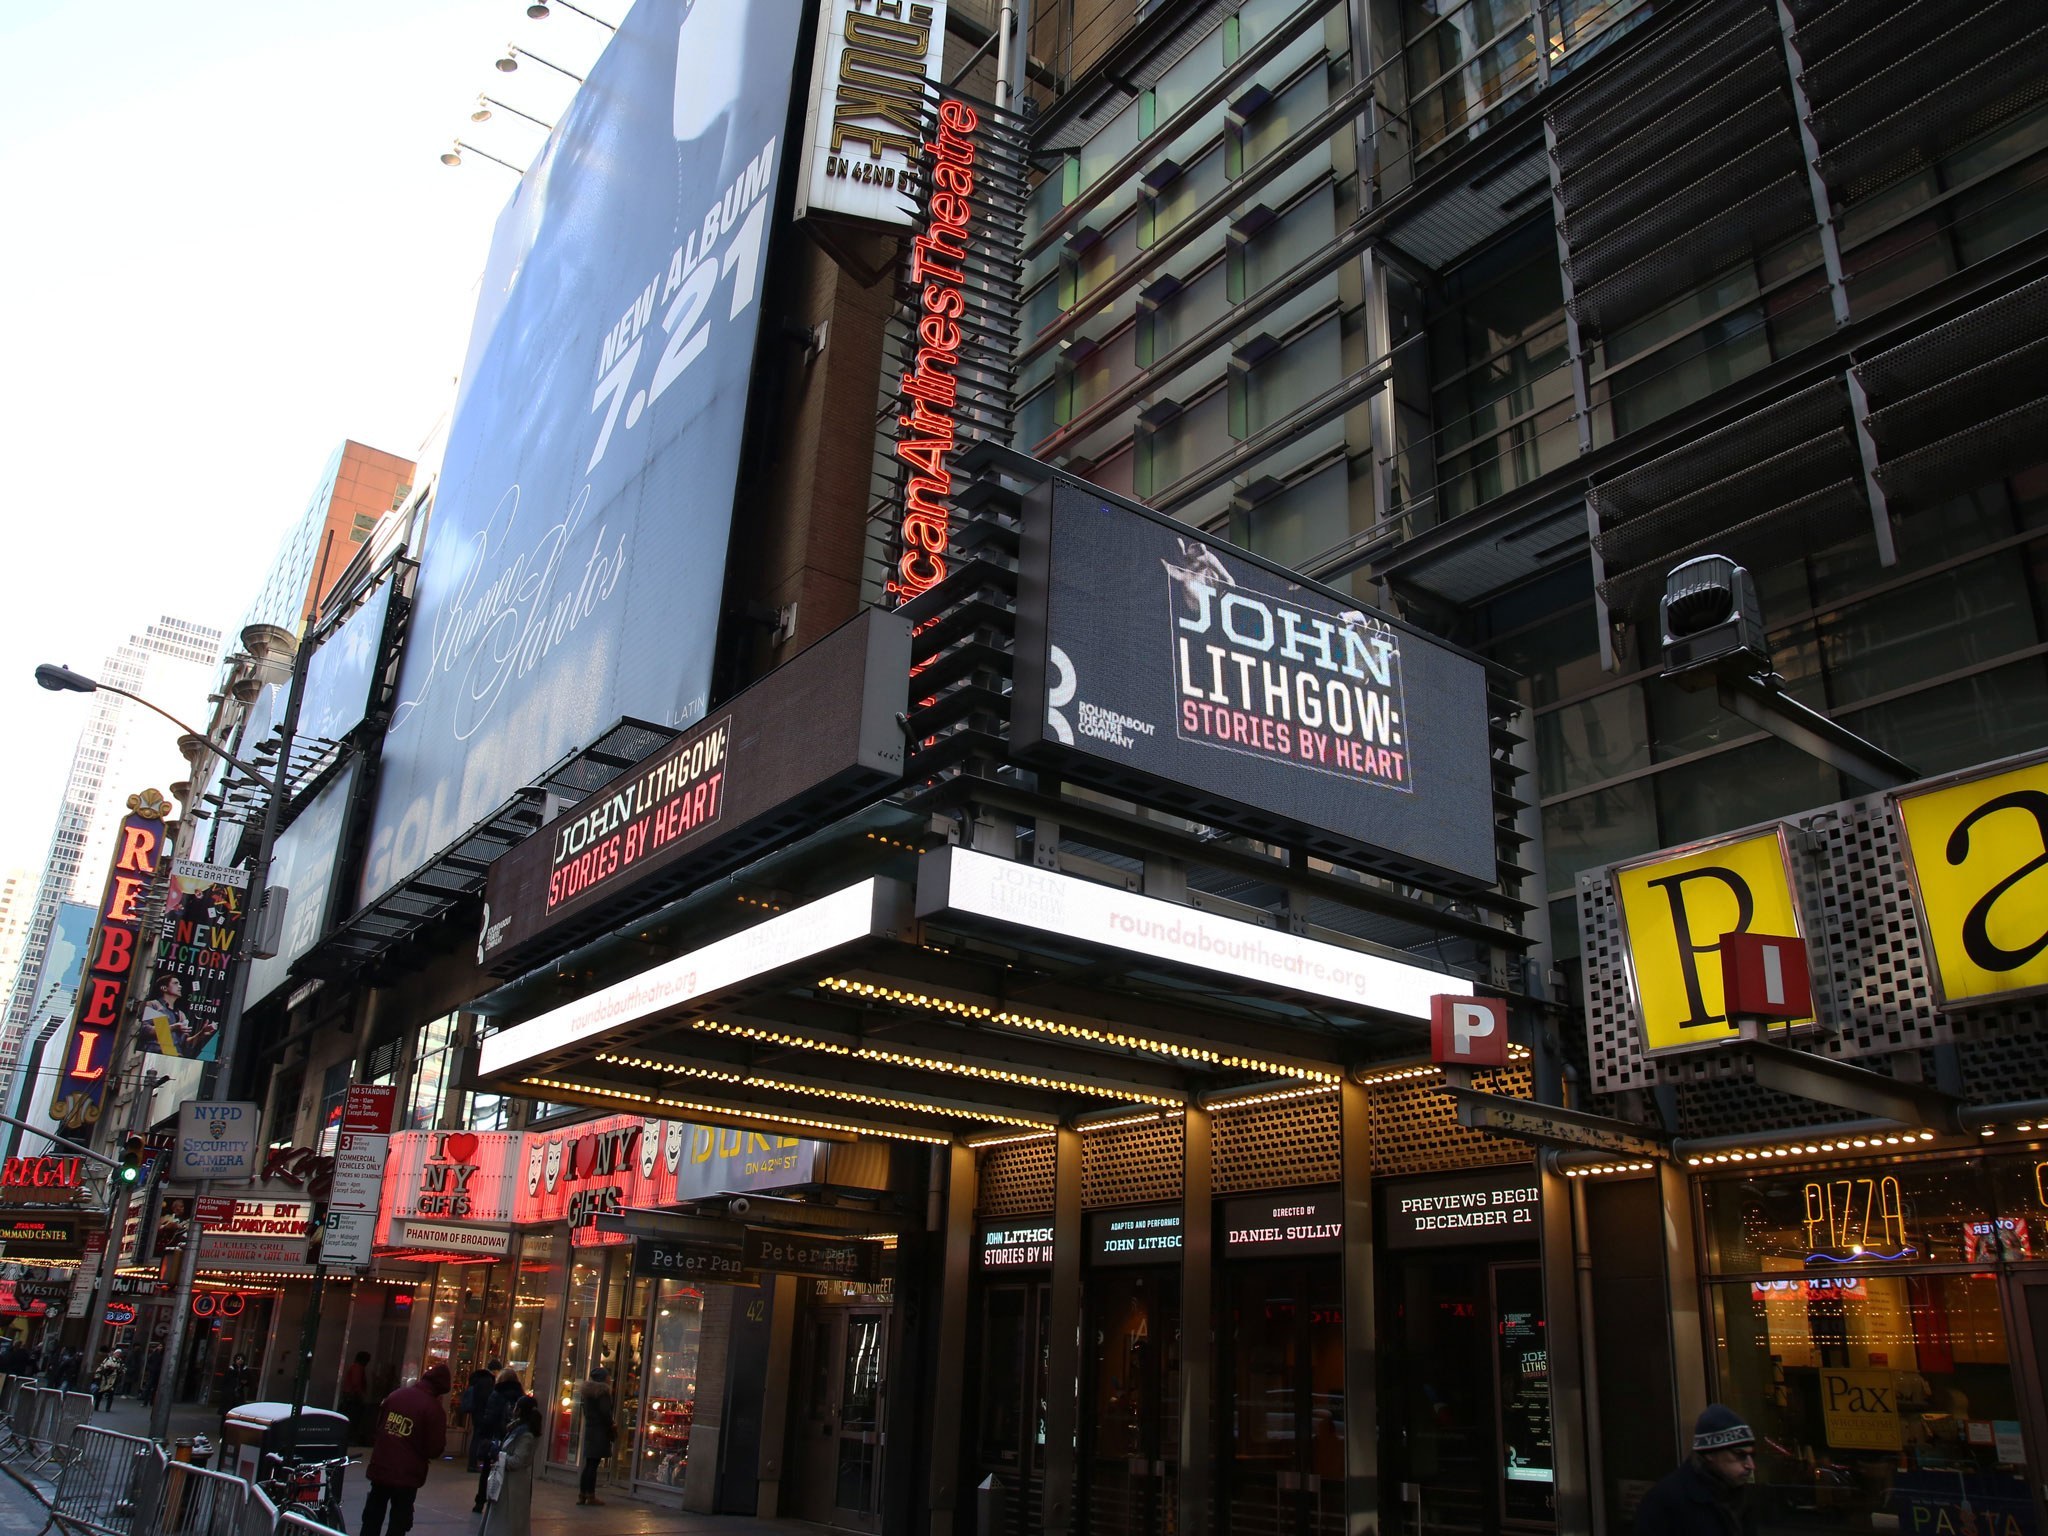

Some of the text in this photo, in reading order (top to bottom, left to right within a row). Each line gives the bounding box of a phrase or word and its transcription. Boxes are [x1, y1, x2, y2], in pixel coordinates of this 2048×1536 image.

[830, 10, 930, 169] DUKE
[826, 155, 849, 179] ON
[852, 161, 895, 188] 42ND
[597, 134, 777, 381] NEW ALBUM
[586, 193, 768, 476] 7.21
[1179, 581, 1393, 687] JOHN
[1179, 636, 1401, 746] LITHGOW:
[1079, 701, 1156, 736] ROUNDABOUT
[1079, 712, 1123, 734] THEATRE
[1078, 722, 1134, 749] COMPANY
[1183, 700, 1404, 781] STORIES BY HEART
[556, 727, 726, 864] JOHN LITHGOW:
[550, 773, 722, 906] STORIES BY HEART
[178, 866, 241, 885] CELEBRATES
[162, 918, 176, 940] THE
[176, 920, 235, 952] NEW
[70, 826, 155, 1080] REBEL
[159, 941, 232, 970] VICTORY
[1109, 909, 1367, 996] roundabouttheatre.org
[157, 958, 226, 981] THEATER
[1762, 944, 1785, 1004] I
[189, 1003, 217, 1014] SEASON
[570, 970, 697, 1033] roundabouttheatre.org
[1453, 1002, 1495, 1054] P
[351, 1087, 390, 1096] NO STANDING
[194, 1107, 242, 1120] NYPD
[363, 1110, 379, 1118] Sunday
[183, 1139, 249, 1152] SECURITY
[342, 1136, 351, 1149] 3
[430, 1132, 447, 1160] I
[563, 1125, 643, 1181] I NY
[185, 1152, 244, 1166] CAMERA
[338, 1162, 381, 1171] VEHICLES ONLY
[340, 1154, 376, 1163] COMMERCIAL
[745, 1162, 759, 1175] ON
[784, 1155, 798, 1169] ST
[1, 1157, 84, 1187] REGAL
[420, 1164, 480, 1192] NY
[273, 1204, 301, 1217] ENT
[417, 1195, 472, 1215] GIFTS
[568, 1186, 624, 1228] GIFTS
[1273, 1206, 1316, 1218] DIRECTED BY
[1401, 1192, 1487, 1214] PREVIEWS
[1803, 1176, 1907, 1249] PIZZA
[328, 1215, 337, 1228] 5
[1111, 1217, 1180, 1231] ADAPTED AND PERFORMED
[1415, 1208, 1532, 1231] DECEMBER 21
[35, 1230, 67, 1240] CENTER
[340, 1240, 357, 1248] Sunday
[406, 1228, 506, 1248] PHANTOM OF BROADWAY
[986, 1231, 1004, 1245] JOHN
[1229, 1226, 1283, 1243] DANIEL
[200, 1248, 220, 1258] UNCH
[227, 1249, 256, 1259] DINNER
[213, 1241, 285, 1251] LUCILLE'S GRILL
[760, 1241, 820, 1262] Peter
[984, 1246, 1025, 1265] STORIES
[1027, 1246, 1040, 1262] BY
[1104, 1239, 1135, 1252] JOHN
[652, 1249, 743, 1273] Peter Pan
[20, 1284, 67, 1296] WESTIN
[816, 1280, 829, 1295] 229
[746, 1301, 765, 1321] 42
[1824, 1376, 1893, 1413] Pax
[387, 1411, 402, 1423] BIG
[1704, 1428, 1745, 1446] YORK
